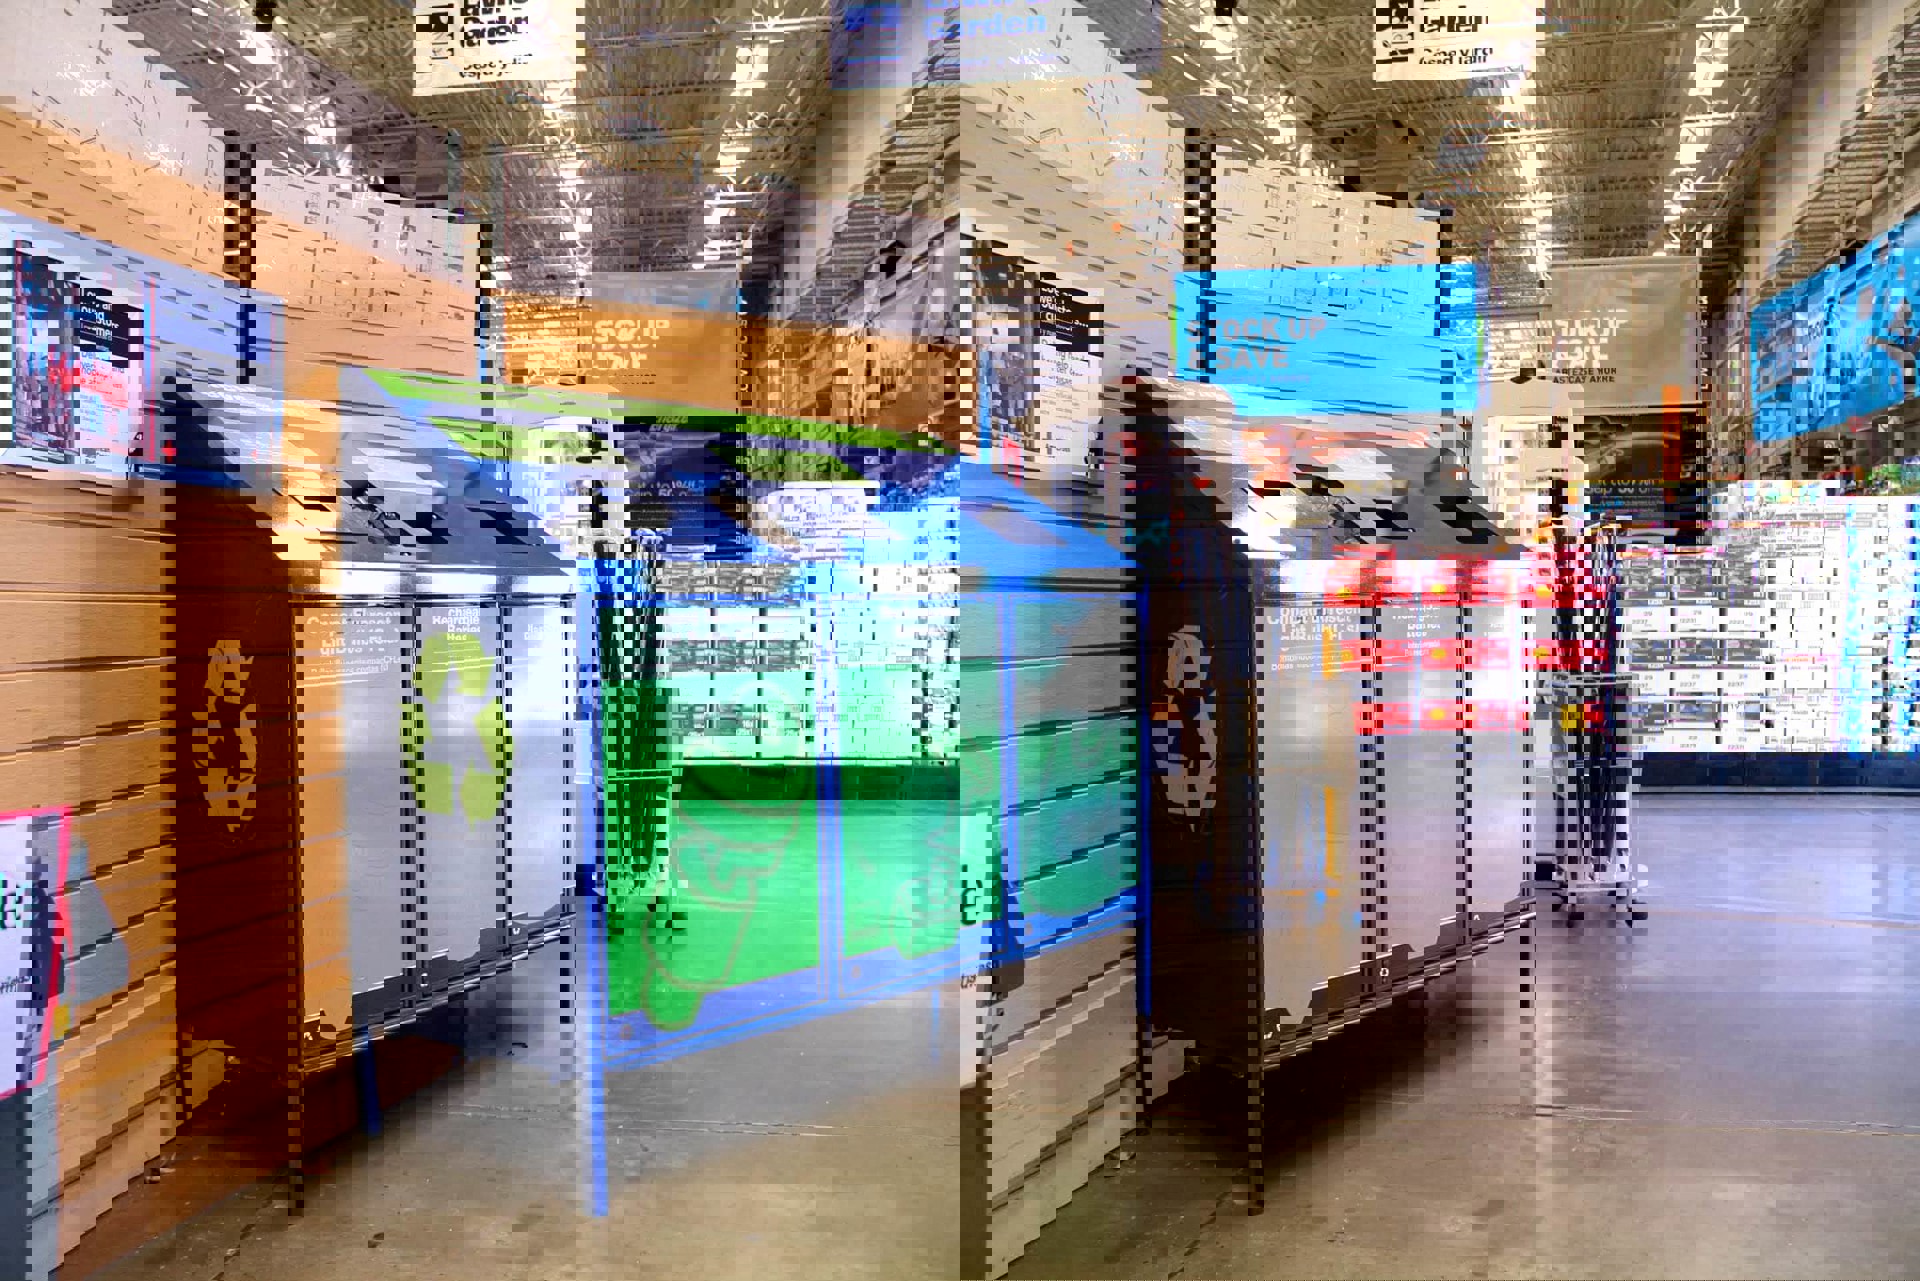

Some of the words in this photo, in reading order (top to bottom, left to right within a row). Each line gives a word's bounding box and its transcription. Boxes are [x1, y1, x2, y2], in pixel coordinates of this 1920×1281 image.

[924, 13, 1046, 41] Garden
[1186, 318, 1280, 343] STOCK
[1287, 316, 1326, 341] UP
[1187, 347, 1208, 371] &
[1214, 345, 1289, 370] SAVE
[626, 608, 700, 630] Compact
[880, 605, 960, 622] Rechargeable
[641, 630, 682, 652] Light
[687, 629, 731, 646] Bulbs
[894, 623, 948, 639] Batteries
